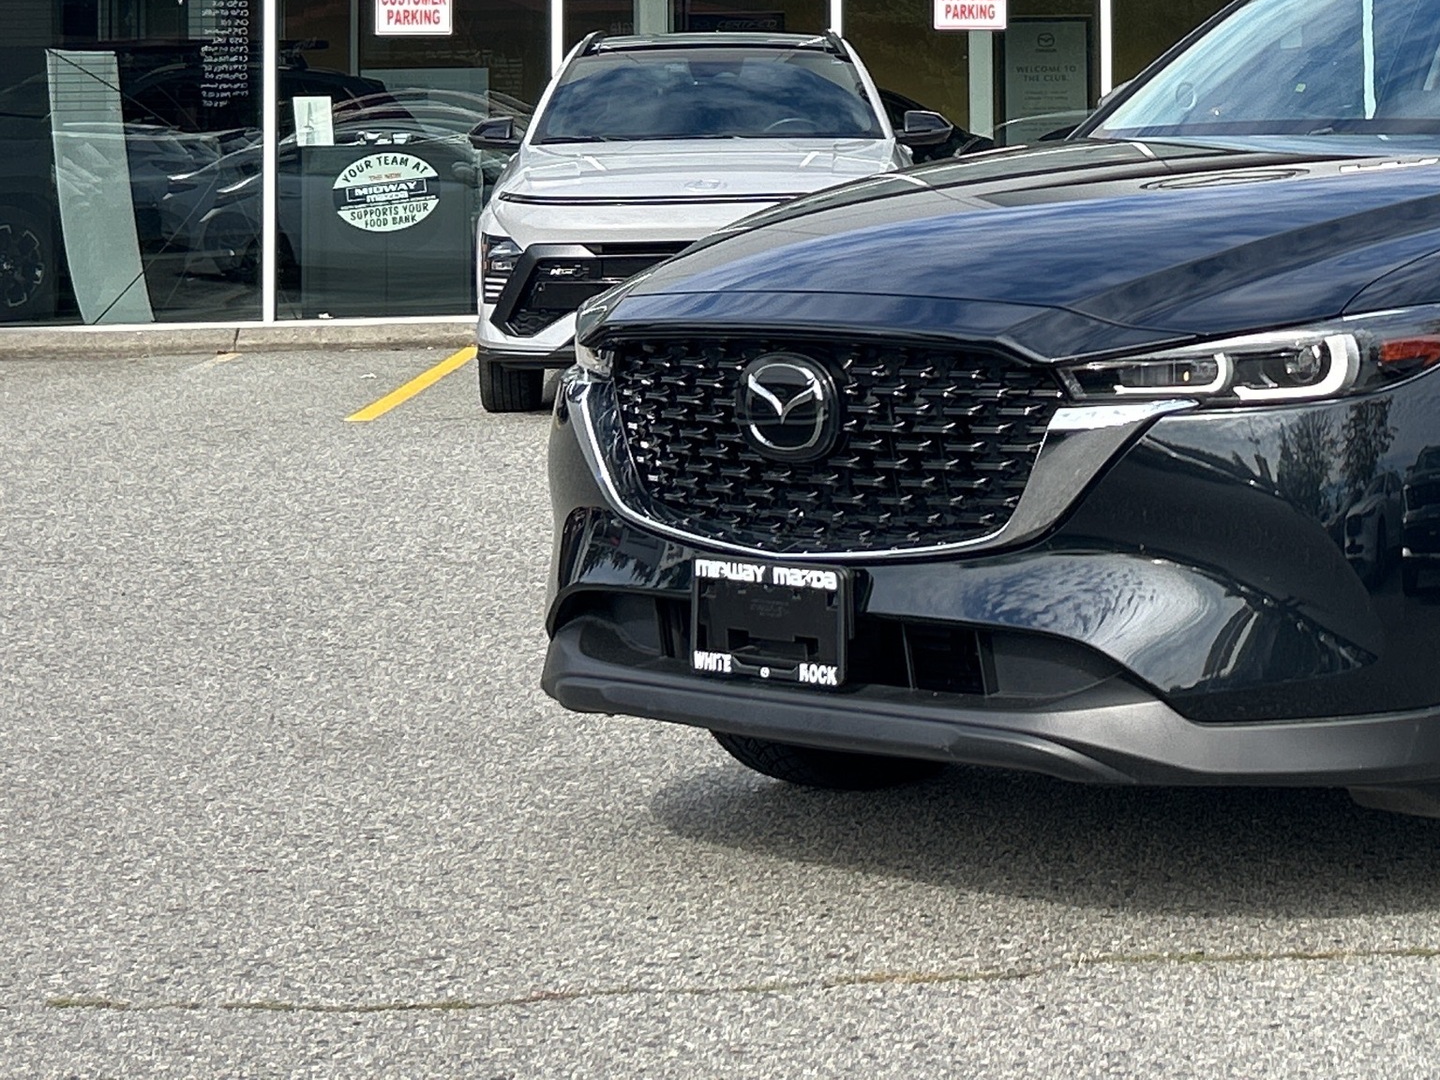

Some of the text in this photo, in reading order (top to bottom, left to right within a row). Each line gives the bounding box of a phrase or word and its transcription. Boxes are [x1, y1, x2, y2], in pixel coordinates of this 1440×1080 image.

[386, 9, 441, 26] PARKING
[945, 4, 996, 20] PARKING
[341, 156, 429, 184] YOUR TEAM AT
[354, 181, 417, 197] MIDWAY
[350, 205, 400, 221] SUPPORTS
[402, 202, 430, 215] YOUR
[364, 214, 418, 229] FOOD BANK
[694, 650, 838, 686] WHITE ROCK
